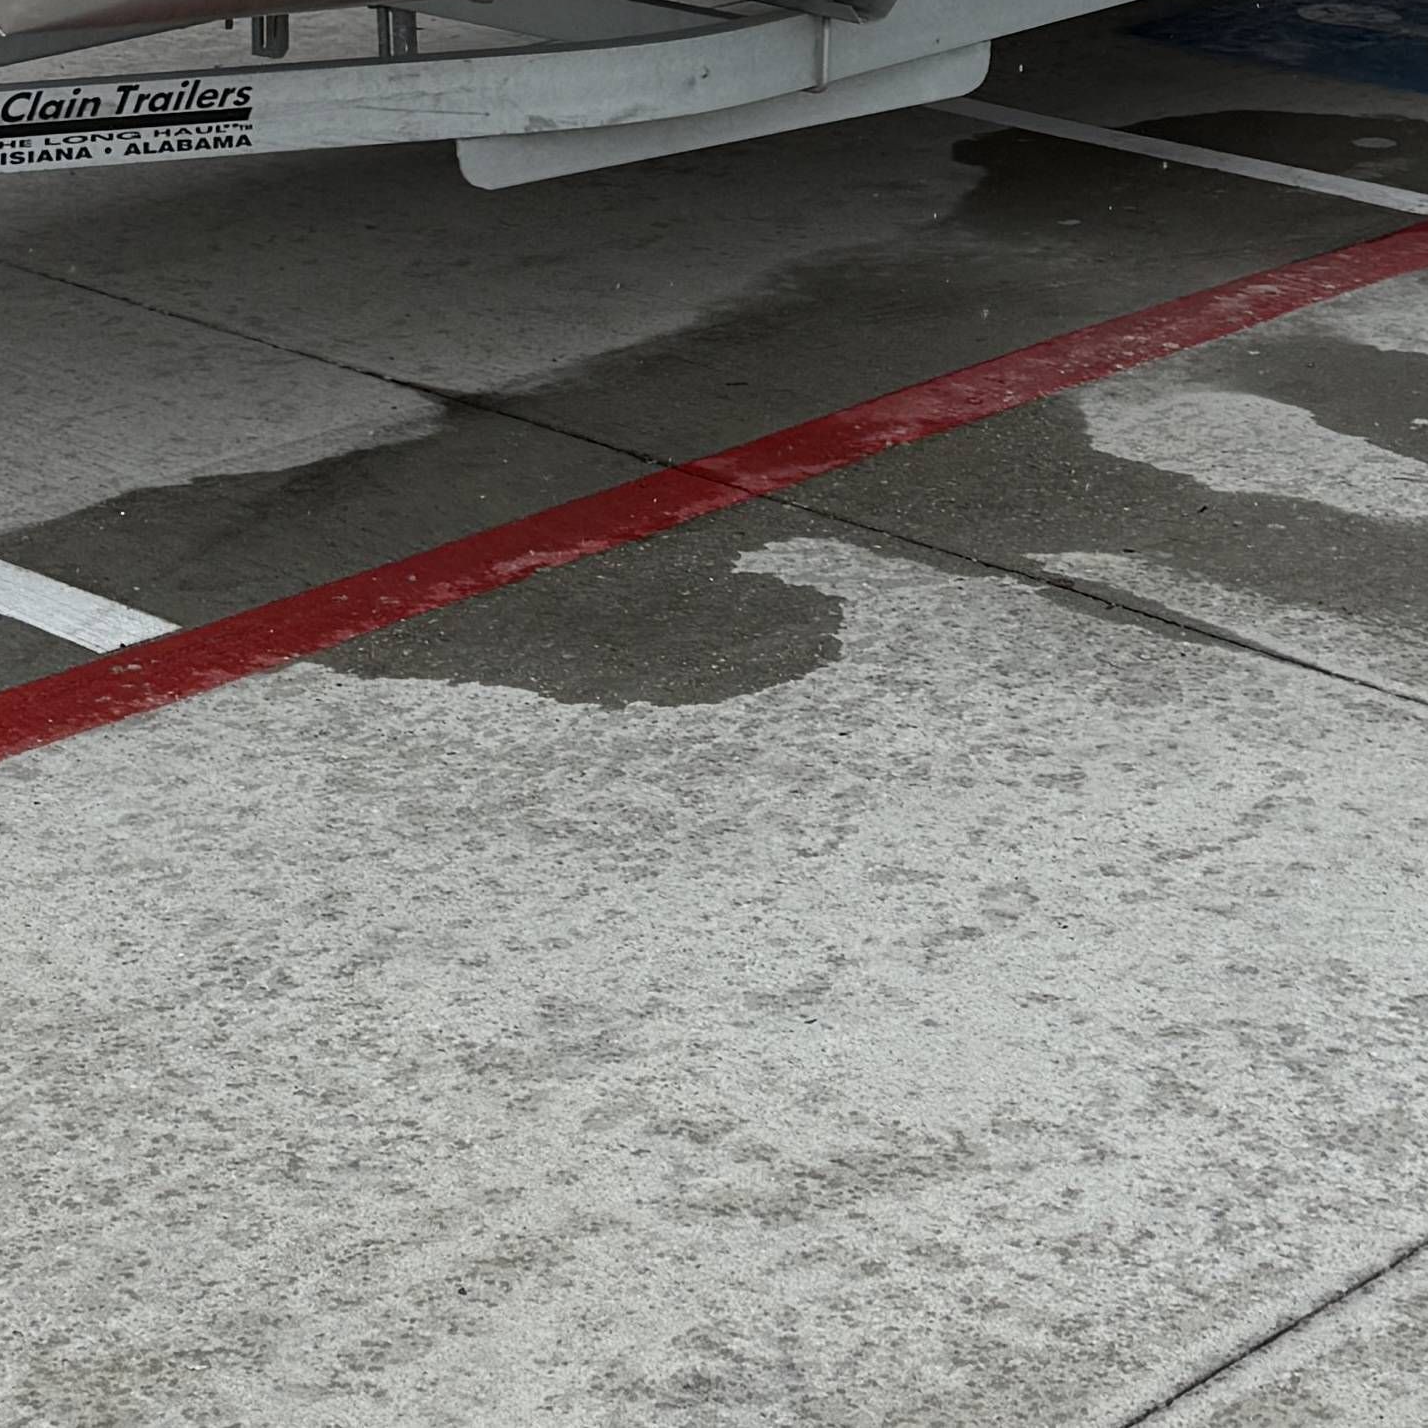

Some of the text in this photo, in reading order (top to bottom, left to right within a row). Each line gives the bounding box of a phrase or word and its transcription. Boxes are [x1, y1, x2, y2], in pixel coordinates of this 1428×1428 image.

[115, 79, 253, 115] Trailers
[44, 131, 142, 146] LONG
[124, 134, 253, 156] ALABAMA
